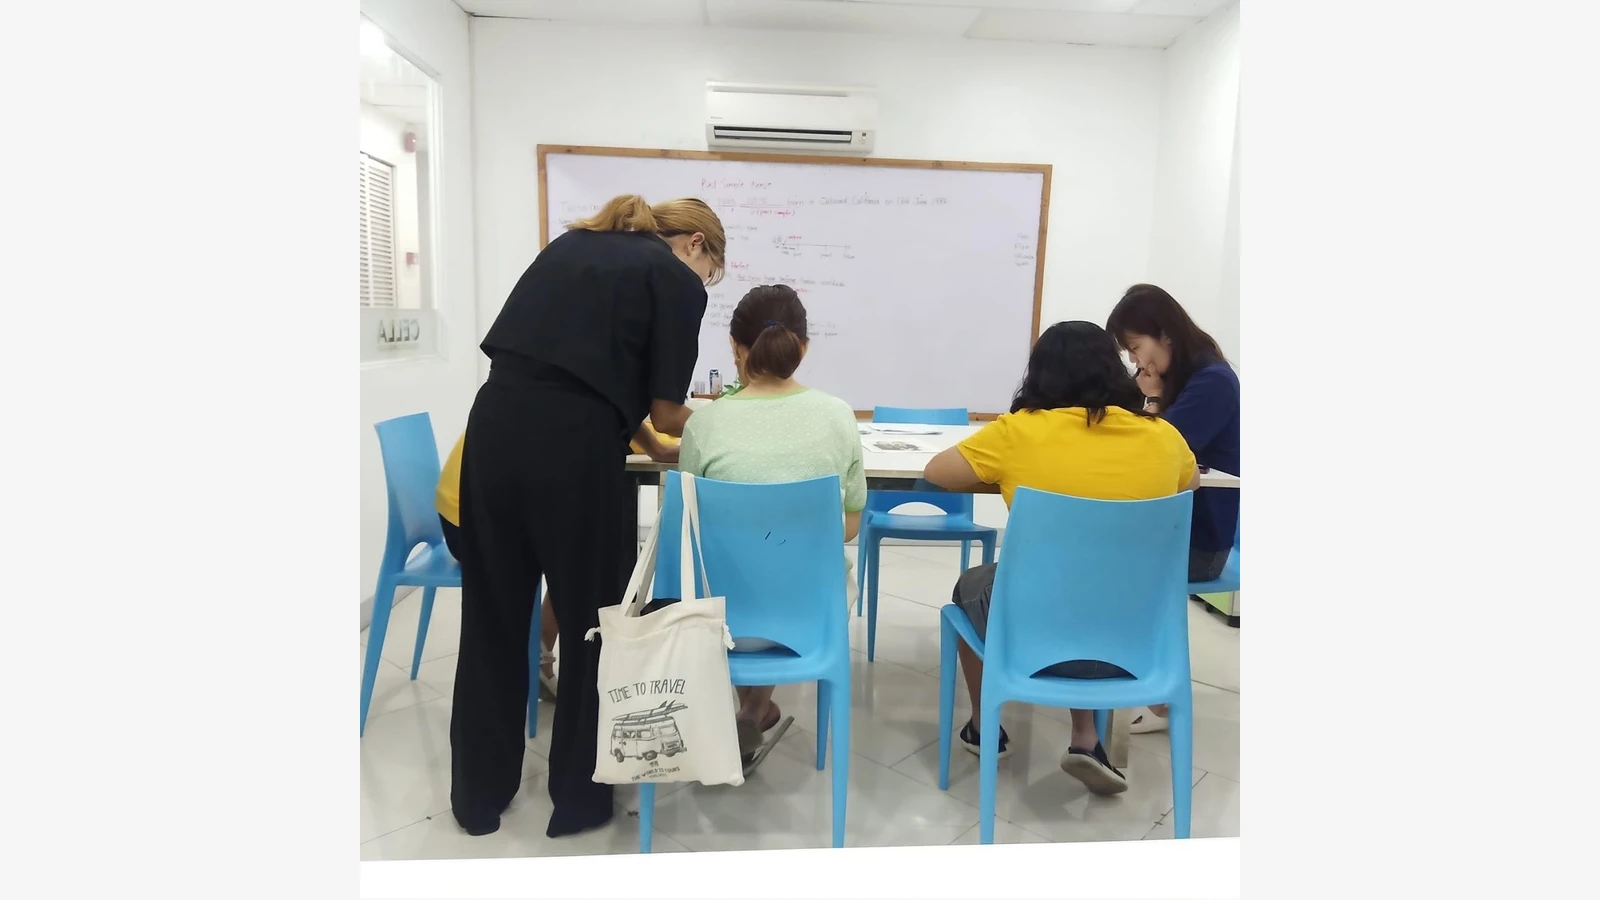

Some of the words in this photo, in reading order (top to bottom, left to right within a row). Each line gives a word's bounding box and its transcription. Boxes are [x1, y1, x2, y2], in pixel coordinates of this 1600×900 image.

[607, 685, 632, 704] TIME
[633, 682, 646, 696] TO
[650, 678, 686, 695] TRAVEL
